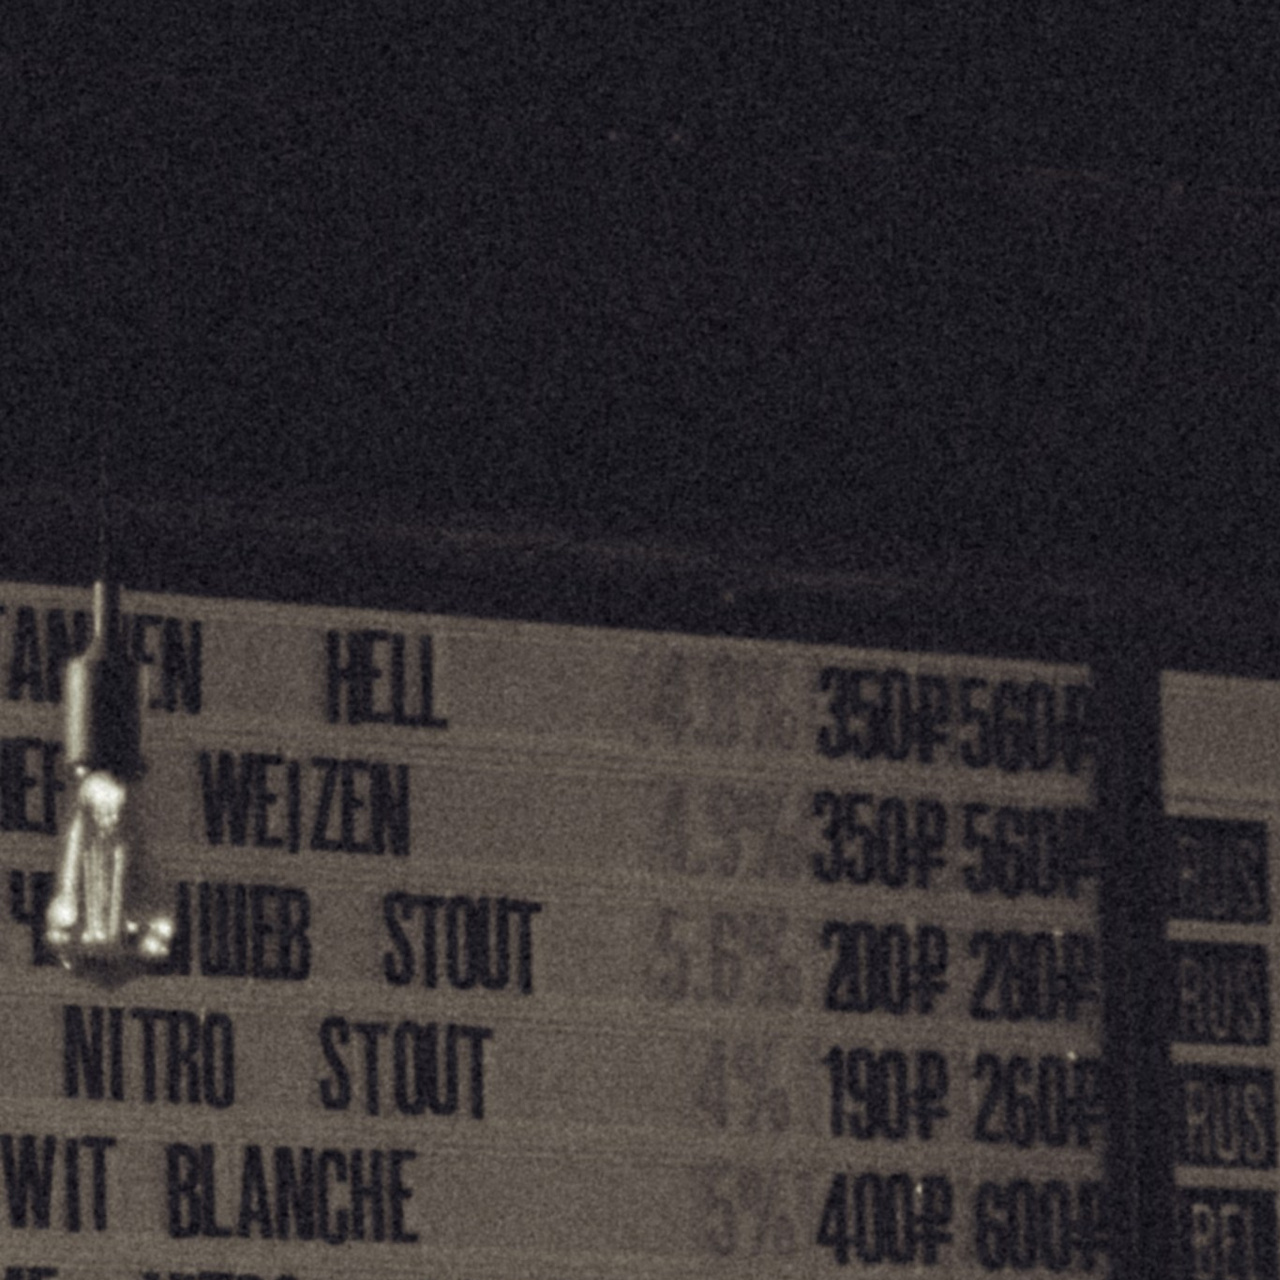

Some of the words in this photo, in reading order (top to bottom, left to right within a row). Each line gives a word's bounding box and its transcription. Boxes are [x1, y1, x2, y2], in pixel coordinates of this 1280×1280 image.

[325, 630, 448, 728] HELL
[200, 750, 410, 857] WEIZEN
[383, 893, 543, 995] STOUT
[63, 1004, 236, 1109] NITRO
[318, 1016, 494, 1120] STOUT
[1185, 1078, 1270, 1165] RUS
[2, 1134, 116, 1233] WIT
[166, 1143, 422, 1246] BLANCHE
